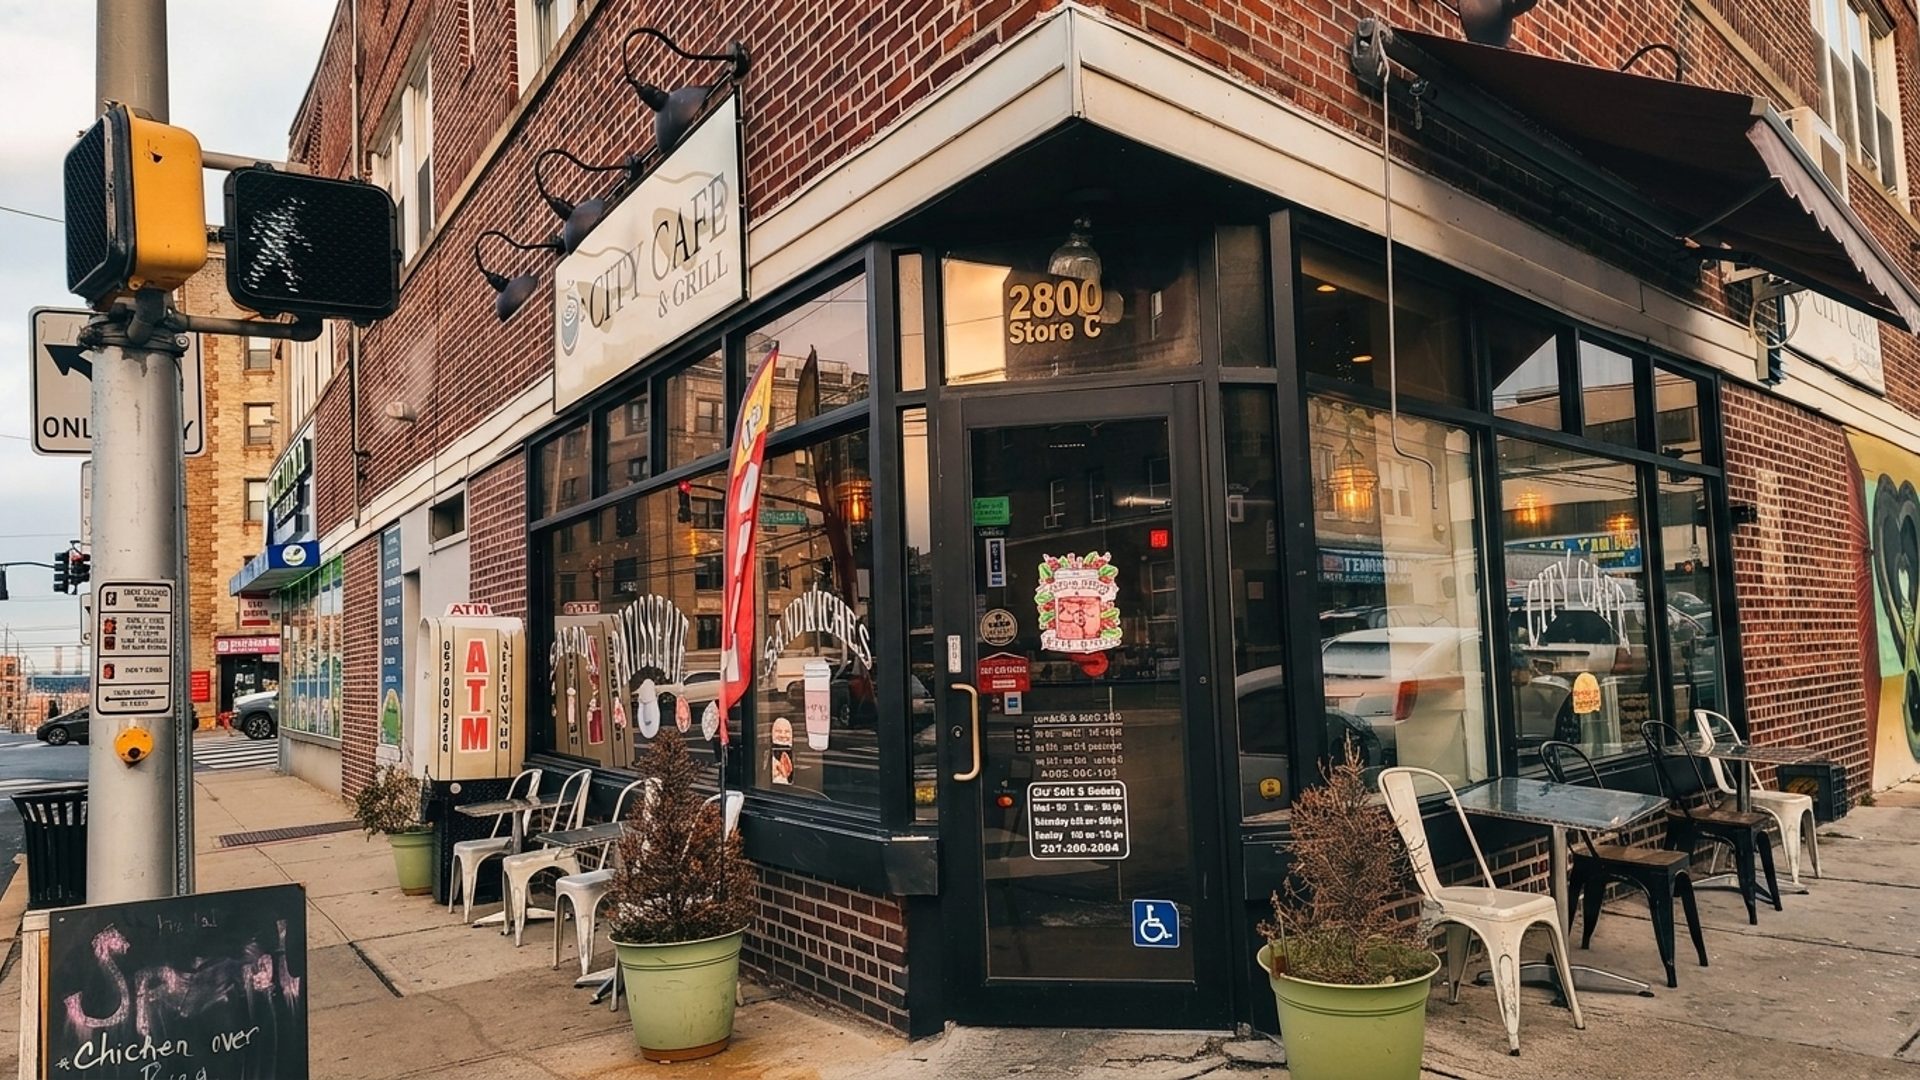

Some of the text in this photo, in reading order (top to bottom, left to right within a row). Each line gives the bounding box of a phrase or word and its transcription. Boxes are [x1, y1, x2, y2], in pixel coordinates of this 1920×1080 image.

[589, 172, 728, 328] CITY CAFE
[673, 250, 728, 307] GRILL
[1009, 280, 1102, 320] 2800
[1009, 315, 1101, 344] Store C
[43, 417, 92, 438] ONL
[451, 604, 489, 615] ATM
[460, 641, 488, 750] ATM
[212, 1026, 260, 1053] over
